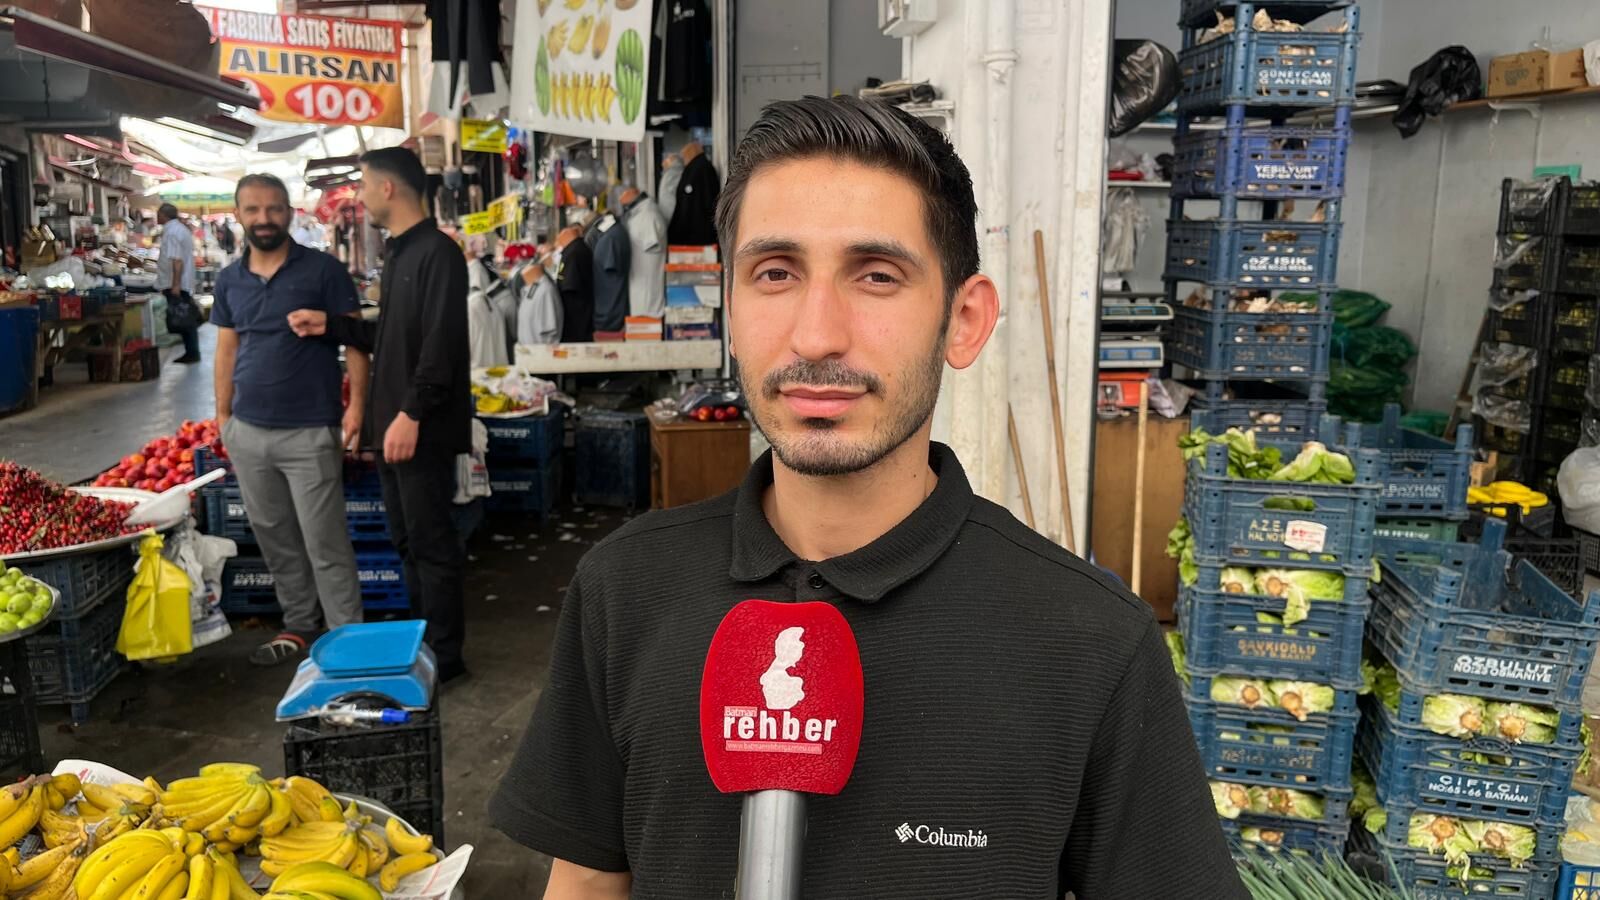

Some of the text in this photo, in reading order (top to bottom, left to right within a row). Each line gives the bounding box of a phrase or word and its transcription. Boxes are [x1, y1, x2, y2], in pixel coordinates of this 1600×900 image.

[287, 16, 330, 49] SATIŞ
[229, 48, 397, 83] ALIRSAN
[294, 84, 373, 121] 100
[723, 710, 837, 742] rehber
[1485, 791, 1529, 803] BATMAN
[915, 824, 988, 848] Columbia
